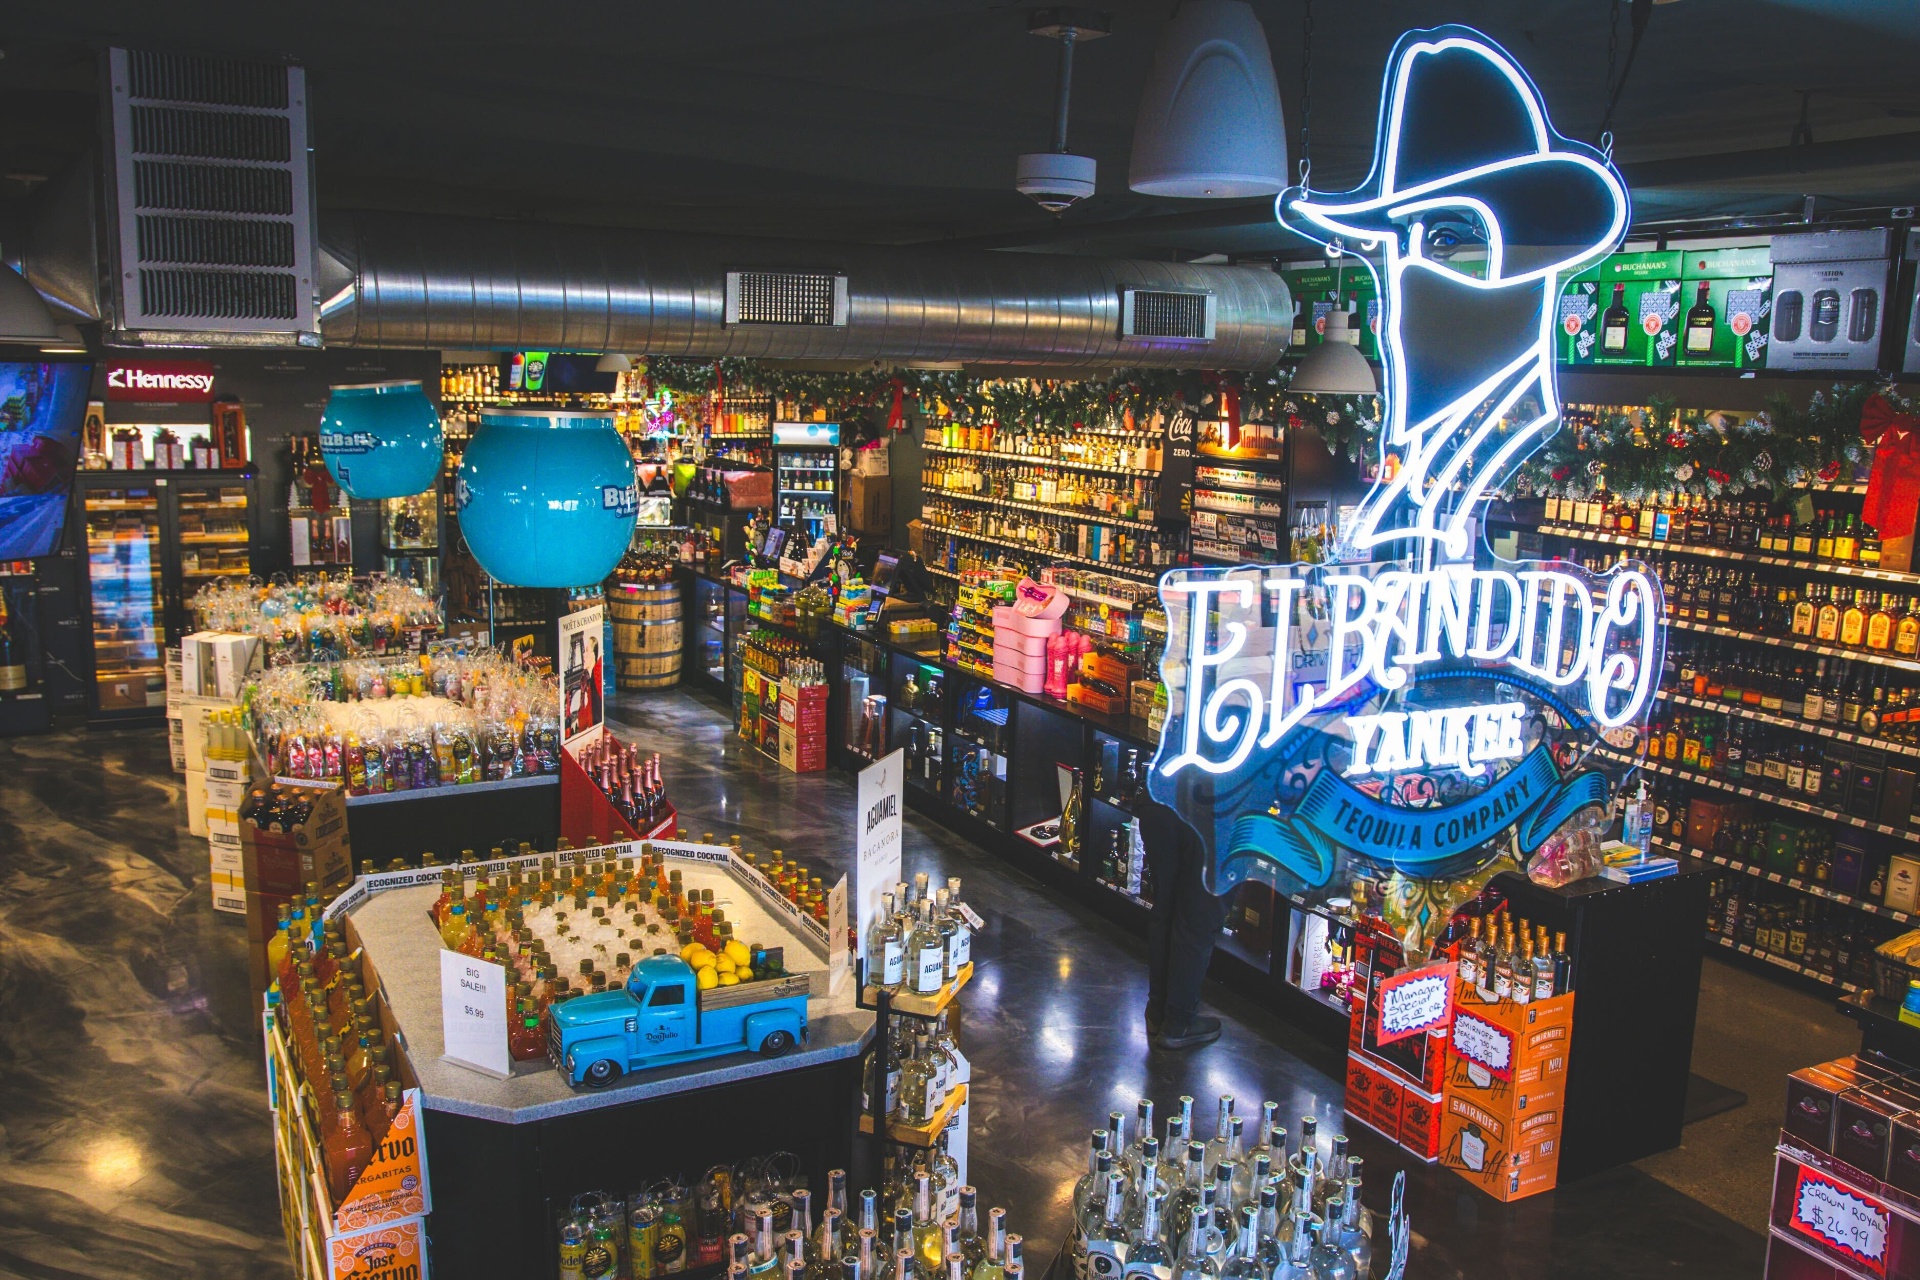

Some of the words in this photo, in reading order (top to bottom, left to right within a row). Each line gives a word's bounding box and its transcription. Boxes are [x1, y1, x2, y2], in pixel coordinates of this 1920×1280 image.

[1622, 261, 1667, 271] BUCHANAN'S
[1707, 259, 1756, 268] BUCHANAN'S
[1302, 275, 1331, 284] BUCHANAN'S
[126, 370, 215, 393] Hennessy
[1173, 448, 1191, 457] ZERO
[581, 612, 602, 627] CHANDON
[1159, 575, 1325, 777] EL
[1312, 570, 1657, 728] BANDIDO
[1344, 701, 1526, 777] YANKEE
[866, 794, 897, 835] AGUAMIEL
[1333, 798, 1421, 849] TEQUILA
[1434, 782, 1530, 848] COMPANY
[863, 829, 899, 861] BACANORA
[653, 846, 695, 858] RECOGNIZED
[696, 852, 730, 862] COCKTAIL
[730, 858, 749, 878] RECOGNIZED
[416, 872, 442, 882] COCKT
[781, 898, 798, 917] COCKTAIL
[1790, 934, 1806, 944] LTD
[466, 968, 480, 979] BIG
[460, 979, 487, 994] SALE!!!
[1391, 984, 1442, 1006] Manager
[464, 1005, 484, 1019] $5.99
[1457, 1028, 1476, 1043] PEACH
[1458, 1019, 1494, 1041] SMIRNOFF
[1532, 1029, 1562, 1045] SMIRNOFF
[1462, 1041, 1493, 1063] $6.99
[1528, 1094, 1544, 1102] GLUTEN
[1454, 1100, 1498, 1133] SMIRNOFF
[1522, 1114, 1553, 1131] SMIRNOFF
[1531, 1128, 1545, 1136] PEACH
[1521, 1177, 1536, 1186] GLUTEN
[362, 1202, 400, 1214] MARGARITA
[1808, 1187, 1845, 1211] CROWN
[1852, 1207, 1883, 1233] ROYAL
[364, 1253, 396, 1273] Jose
